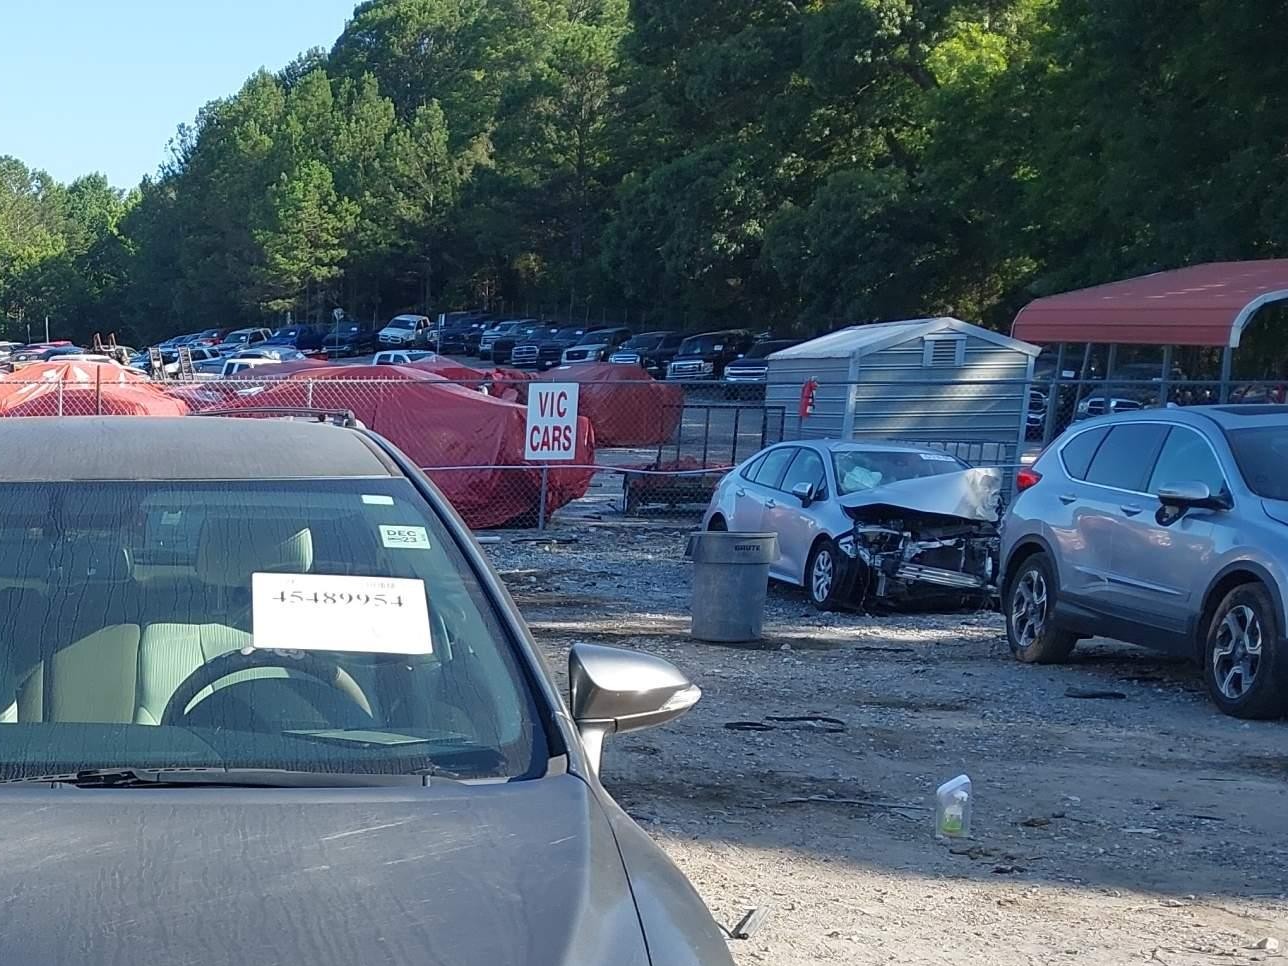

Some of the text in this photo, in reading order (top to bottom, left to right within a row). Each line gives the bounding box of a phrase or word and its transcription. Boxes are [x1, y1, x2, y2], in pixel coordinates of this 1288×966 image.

[538, 390, 568, 418] VIC
[529, 425, 572, 452] CARS
[386, 529, 417, 537] DEC
[271, 590, 405, 608] 45489954
